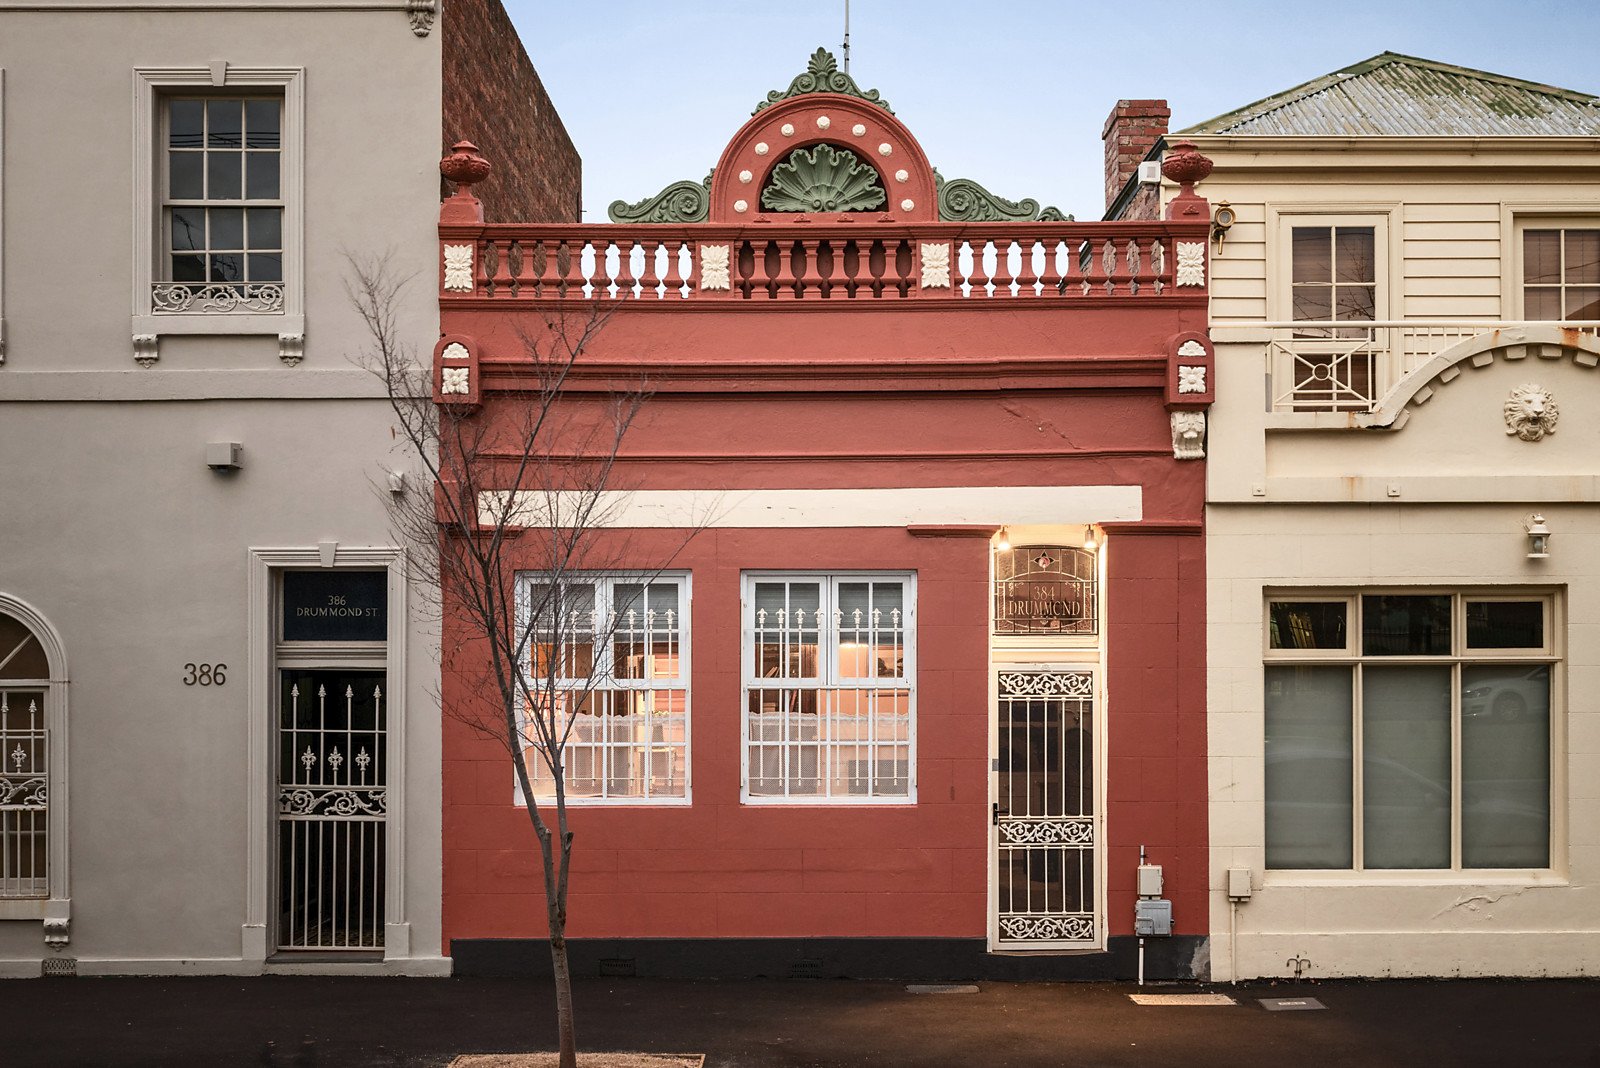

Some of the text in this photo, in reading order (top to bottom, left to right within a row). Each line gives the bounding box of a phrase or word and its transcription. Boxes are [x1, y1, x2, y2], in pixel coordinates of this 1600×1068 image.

[328, 595, 347, 606] 386
[1033, 585, 1055, 601] 384
[296, 607, 363, 617] DRUMMOND
[1008, 600, 1081, 616] DRUMMOND
[183, 662, 228, 687] 386
